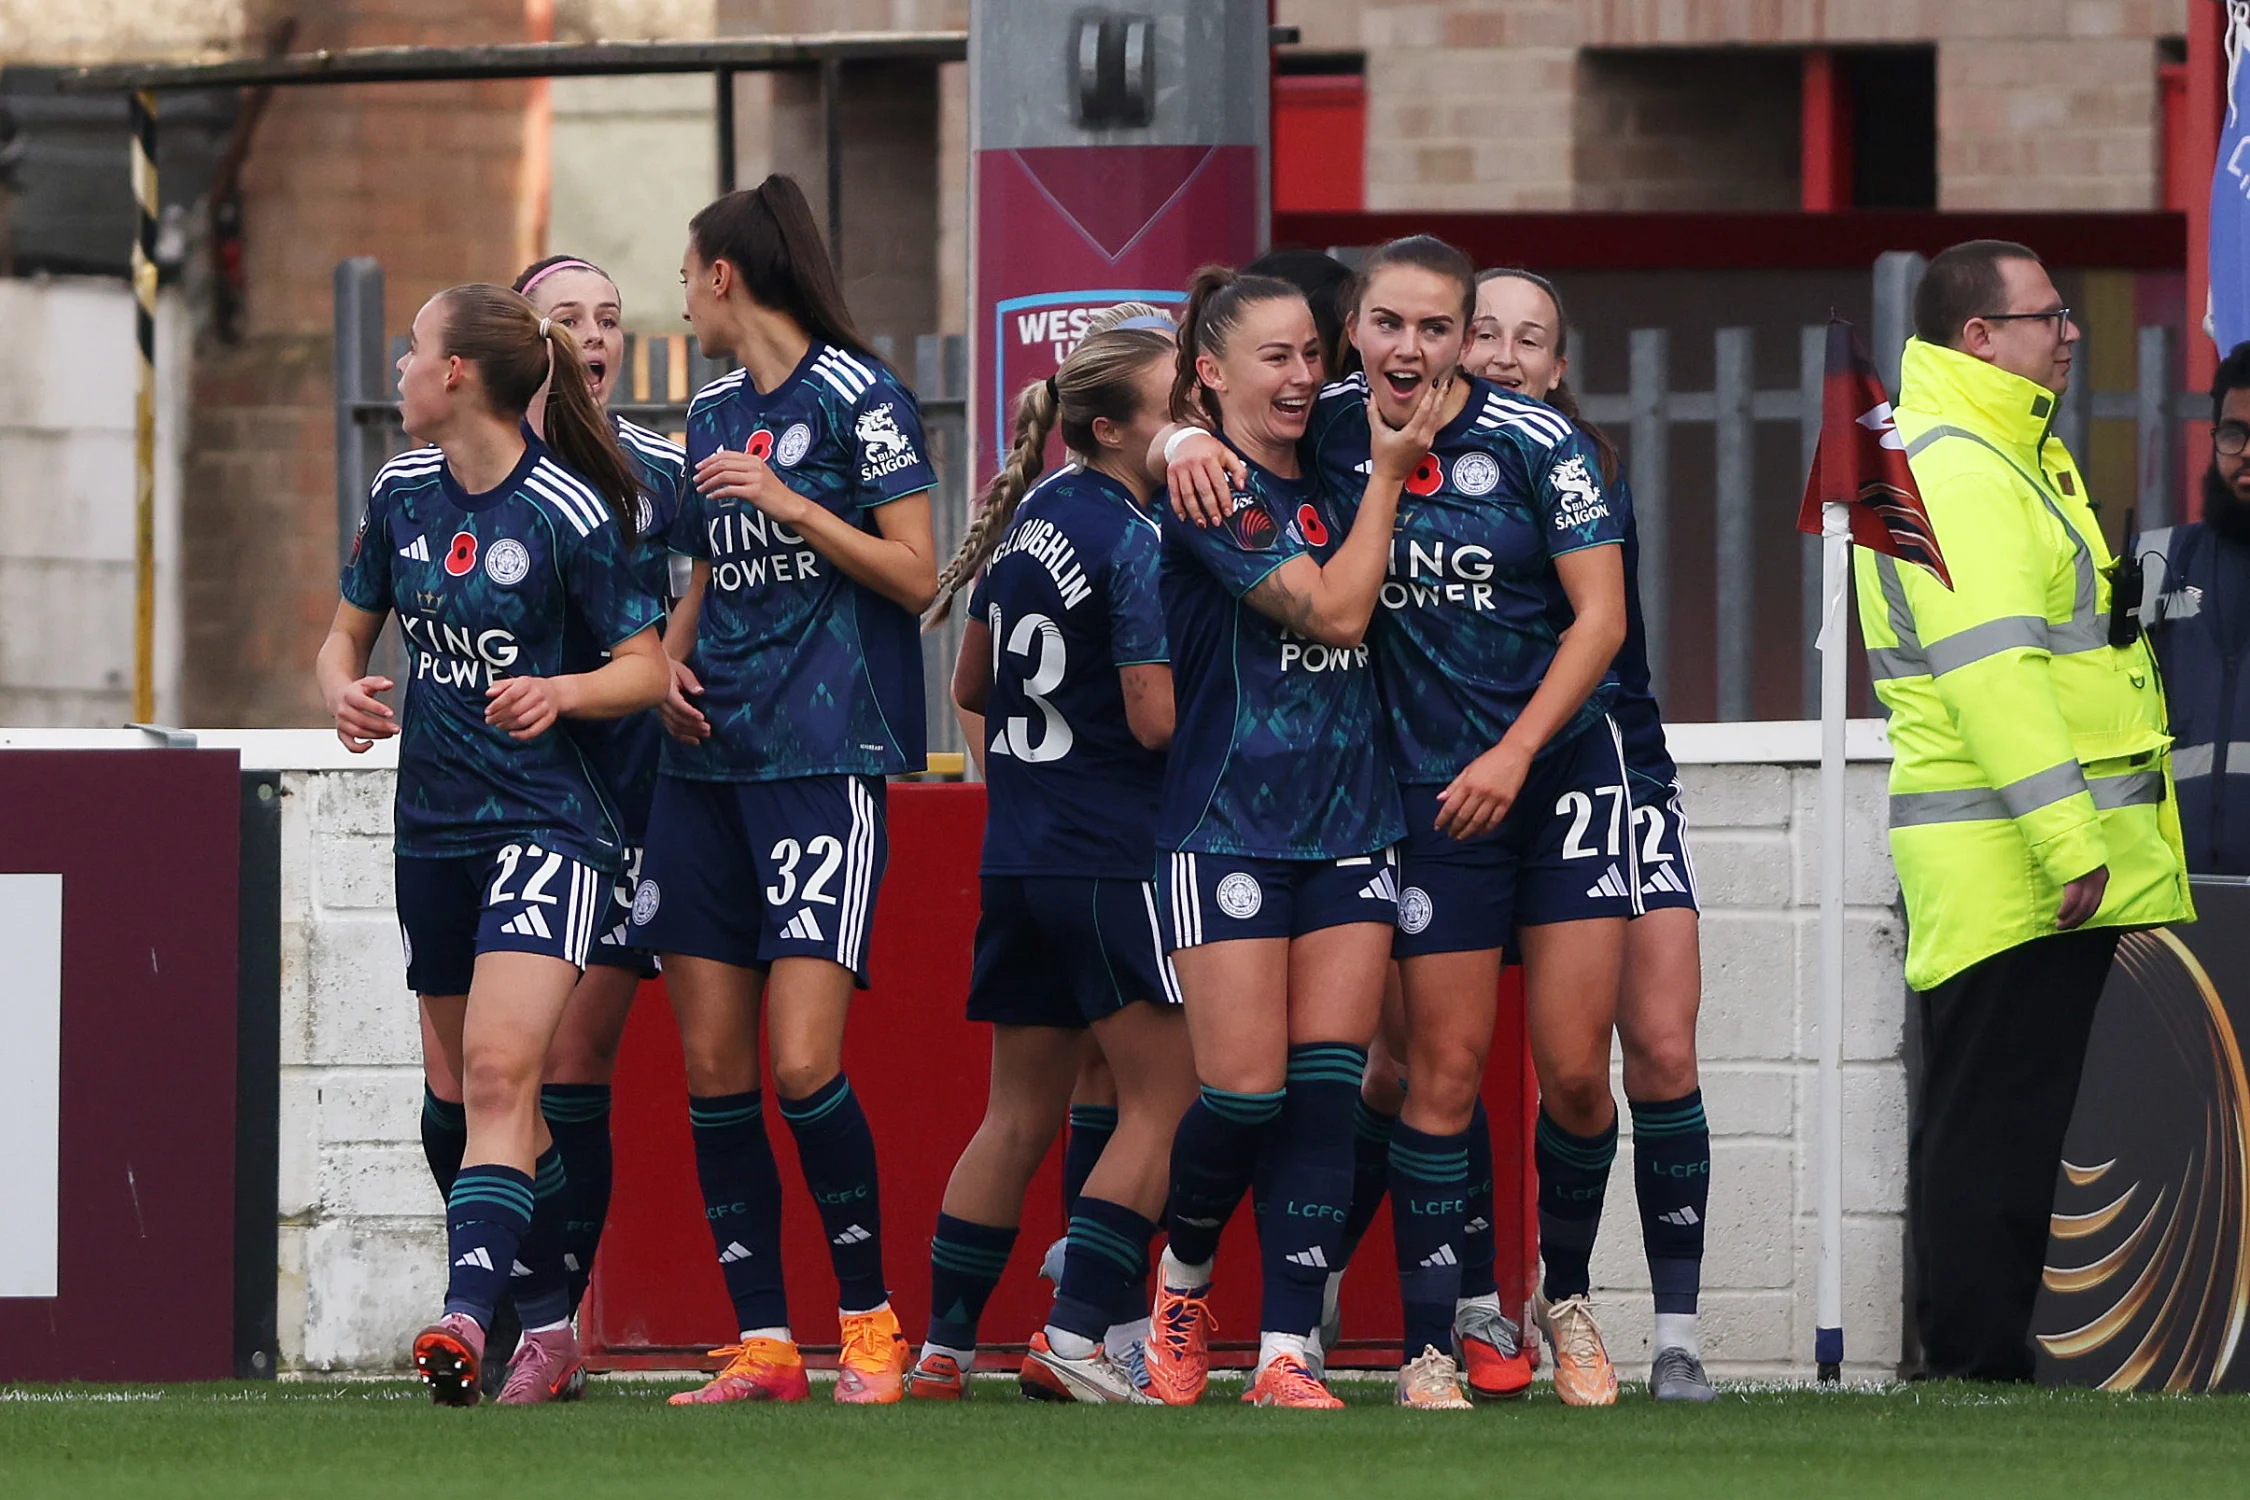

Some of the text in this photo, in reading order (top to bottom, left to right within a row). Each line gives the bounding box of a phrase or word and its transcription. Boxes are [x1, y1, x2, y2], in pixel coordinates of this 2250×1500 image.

[861, 451, 918, 481] SAIGON
[1555, 504, 1610, 530] SAIGON
[1387, 539, 1495, 581] ING
[1379, 582, 1497, 612] OWER
[401, 613, 519, 667] KING
[1555, 785, 1624, 861] 27
[489, 844, 563, 906] 22
[766, 835, 844, 906] 32
[1653, 1160, 1709, 1178] LCFC
[1410, 1199, 1464, 1215] LCFC
[1556, 1185, 1603, 1200] LCF
[704, 1202, 747, 1219] CFC
[1287, 1201, 1346, 1223] LCFC
